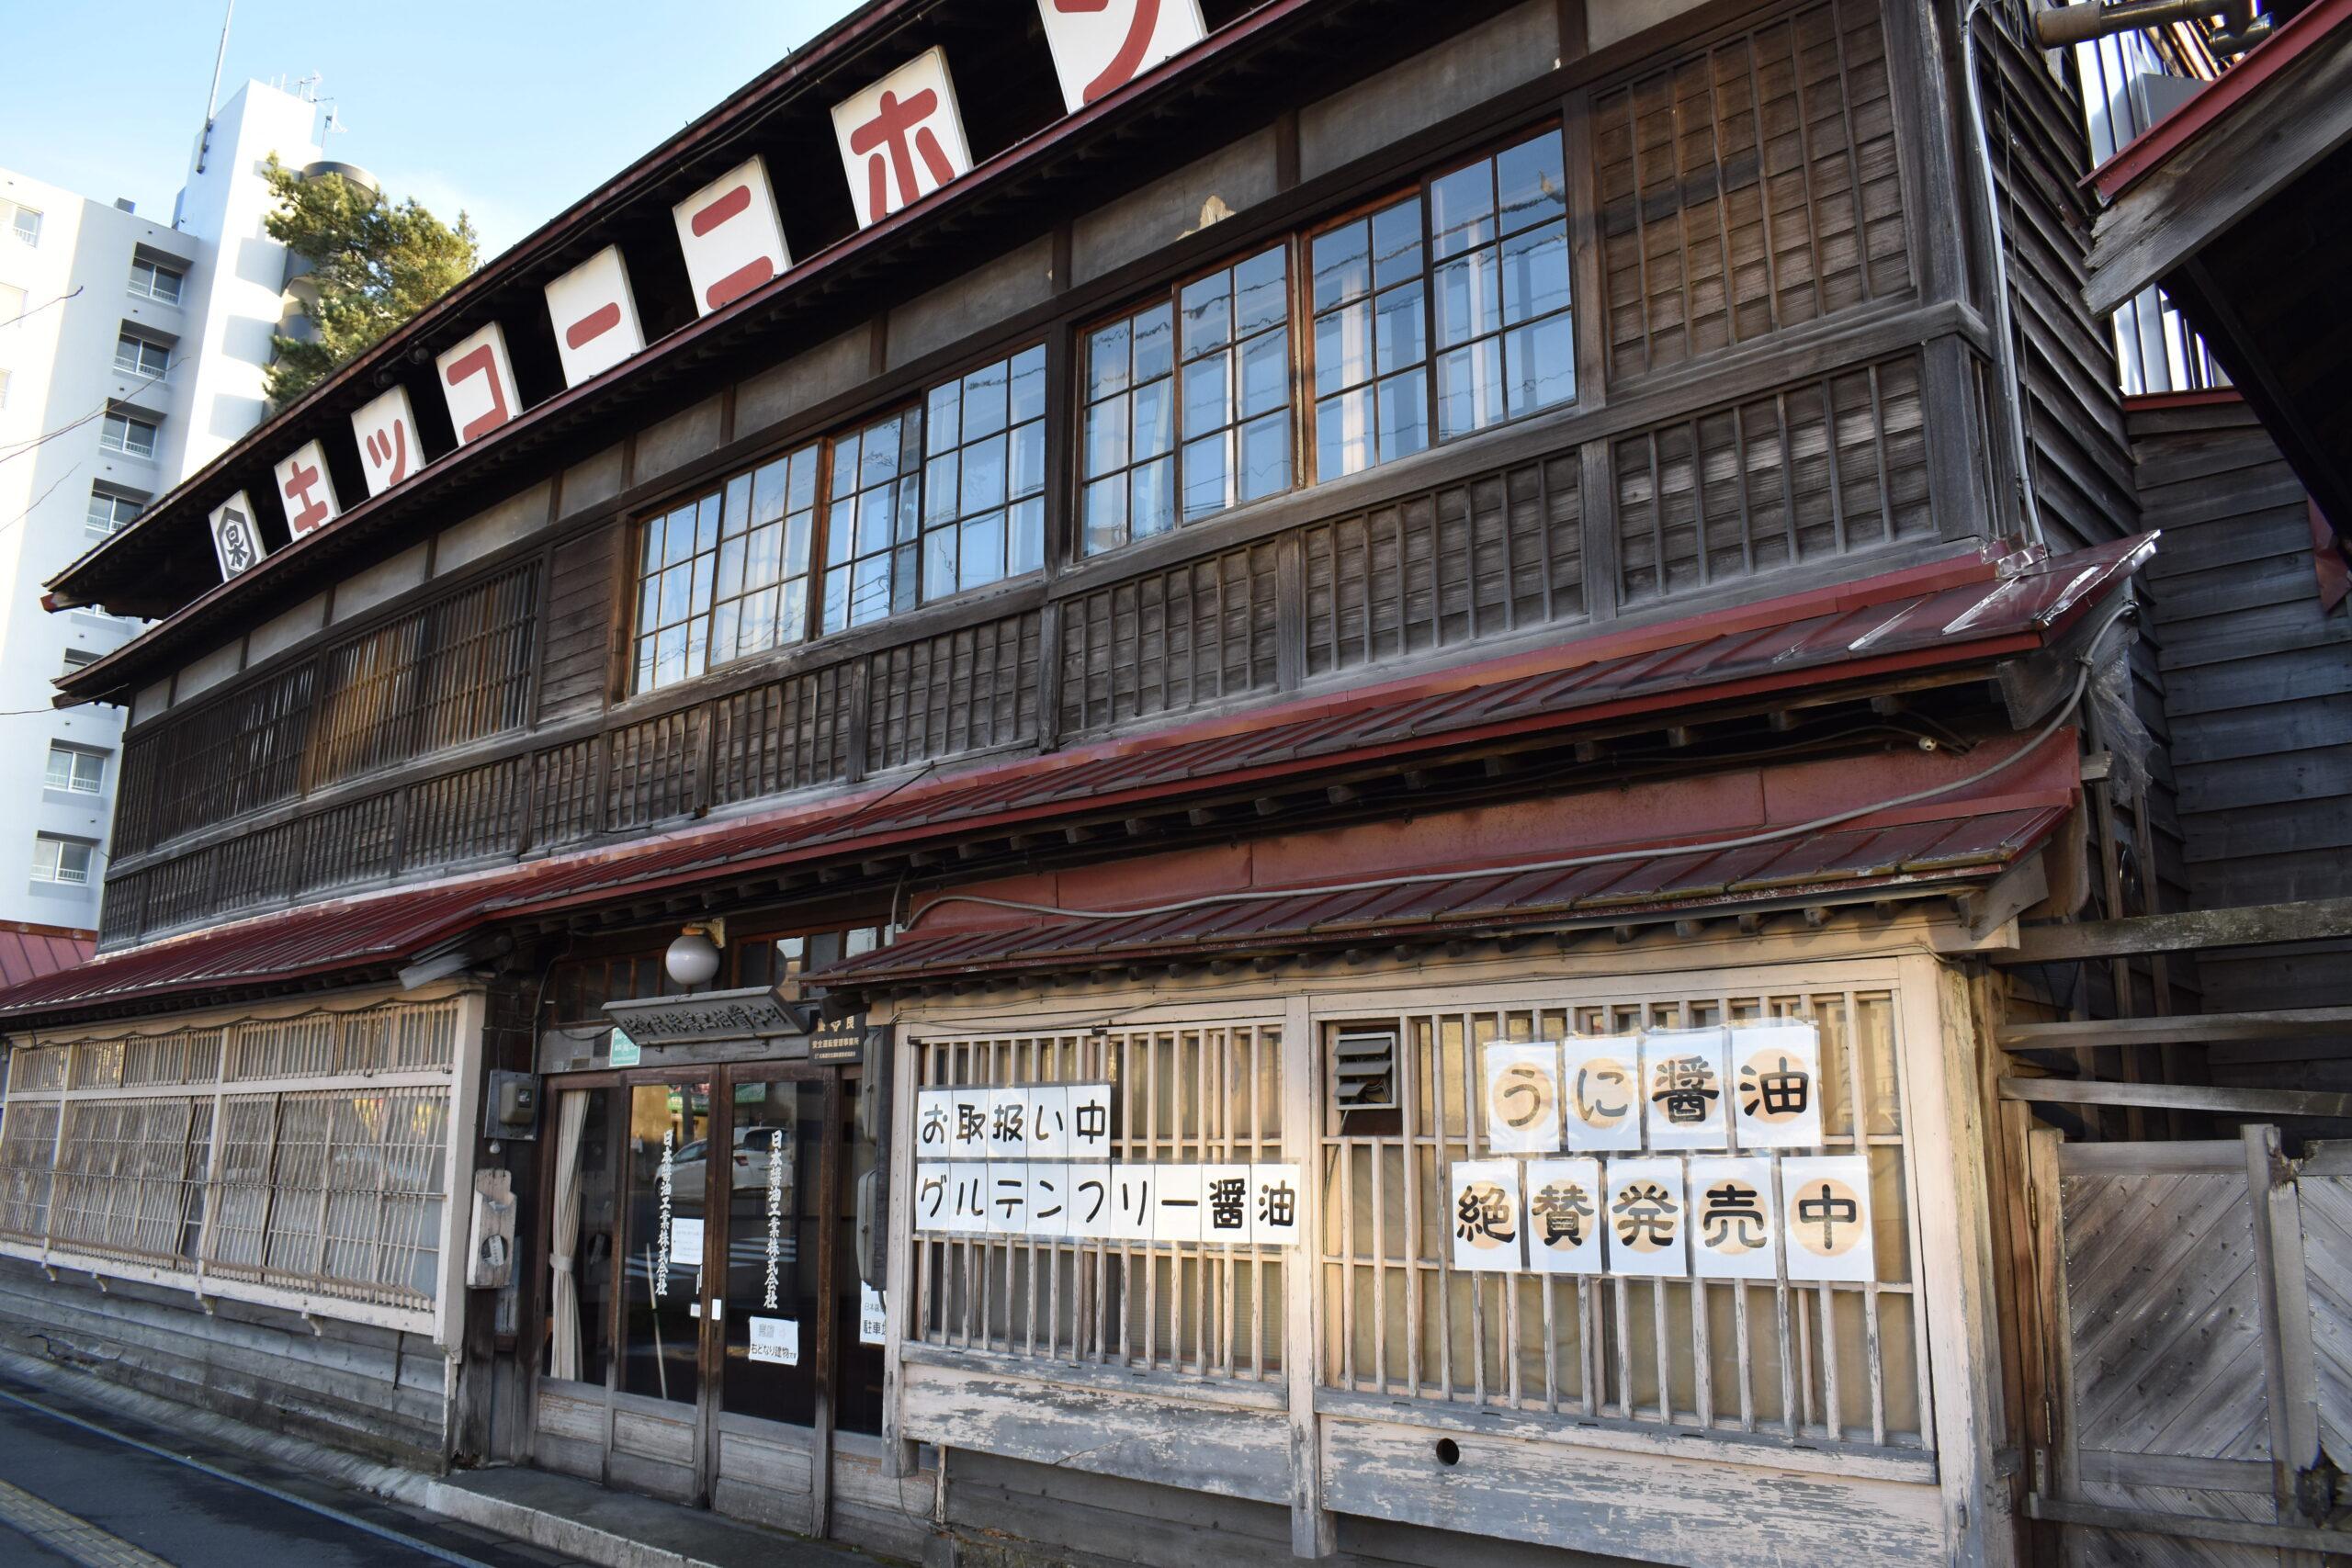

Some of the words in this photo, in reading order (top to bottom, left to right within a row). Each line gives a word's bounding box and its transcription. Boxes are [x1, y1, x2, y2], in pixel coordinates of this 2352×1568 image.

[922, 1100, 1106, 1145] お取扱い中
[1502, 1055, 1810, 1128] うに醤油
[655, 1127, 673, 1296] 日本醤油工業株式会社
[763, 1130, 782, 1310] 日本醤油工業株式会社
[921, 1174, 1295, 1229] グルテンフリー醤油
[1457, 1184, 1857, 1250] 絶賛発売中
[752, 1343, 797, 1359] 右どなり建物です
